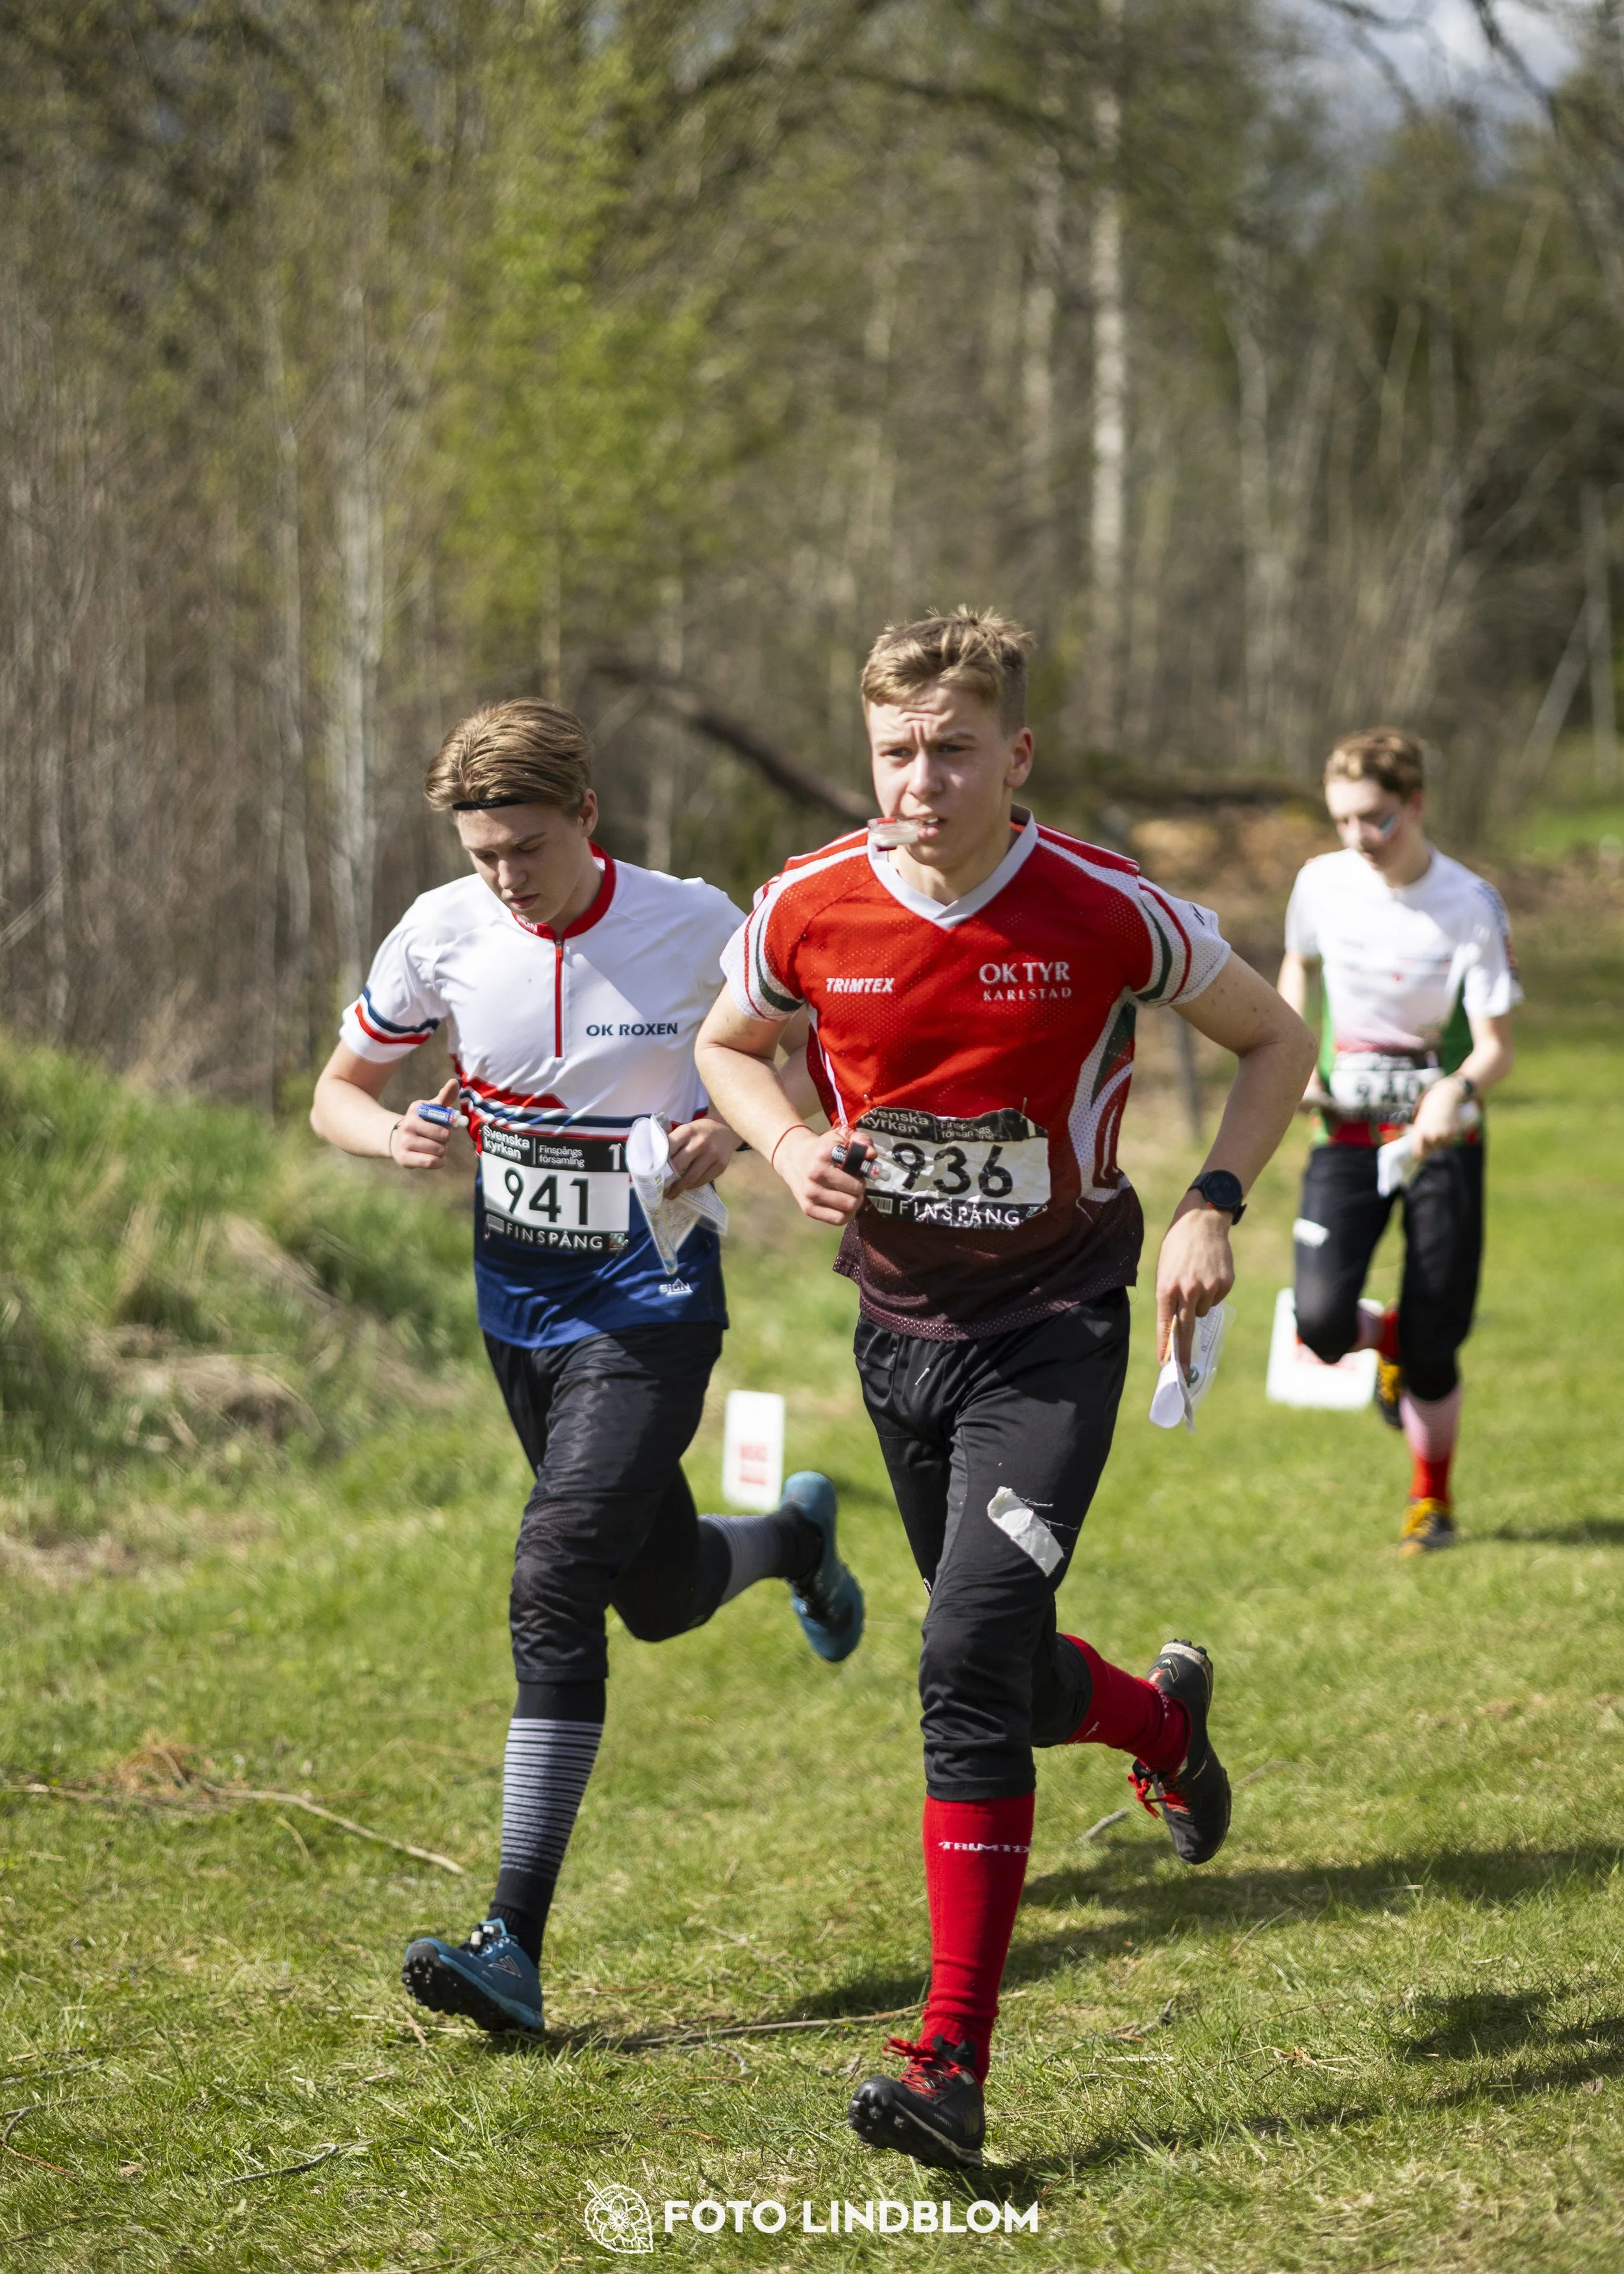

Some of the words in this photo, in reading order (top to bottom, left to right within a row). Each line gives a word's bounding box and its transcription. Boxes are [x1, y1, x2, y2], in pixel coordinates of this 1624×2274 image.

[979, 963, 1017, 984] OK
[1022, 962, 1071, 981] TYR
[826, 977, 895, 993] TRIMTEX
[983, 987, 1072, 1001] KARLSTAD
[586, 1024, 614, 1036] OK
[618, 1023, 678, 1036] ROXEN
[871, 1109, 929, 1125] venska
[483, 1125, 530, 1149] Svenska
[485, 1136, 522, 1160] kyrkan
[539, 1144, 583, 1157] Finspångs
[539, 1155, 585, 1168] församling
[608, 1144, 621, 1170] 1
[892, 1142, 1013, 1198] 936
[505, 1167, 589, 1225] 941
[900, 1201, 1021, 1226] FINSPÅNG
[507, 1222, 603, 1249] FINSPÅNG
